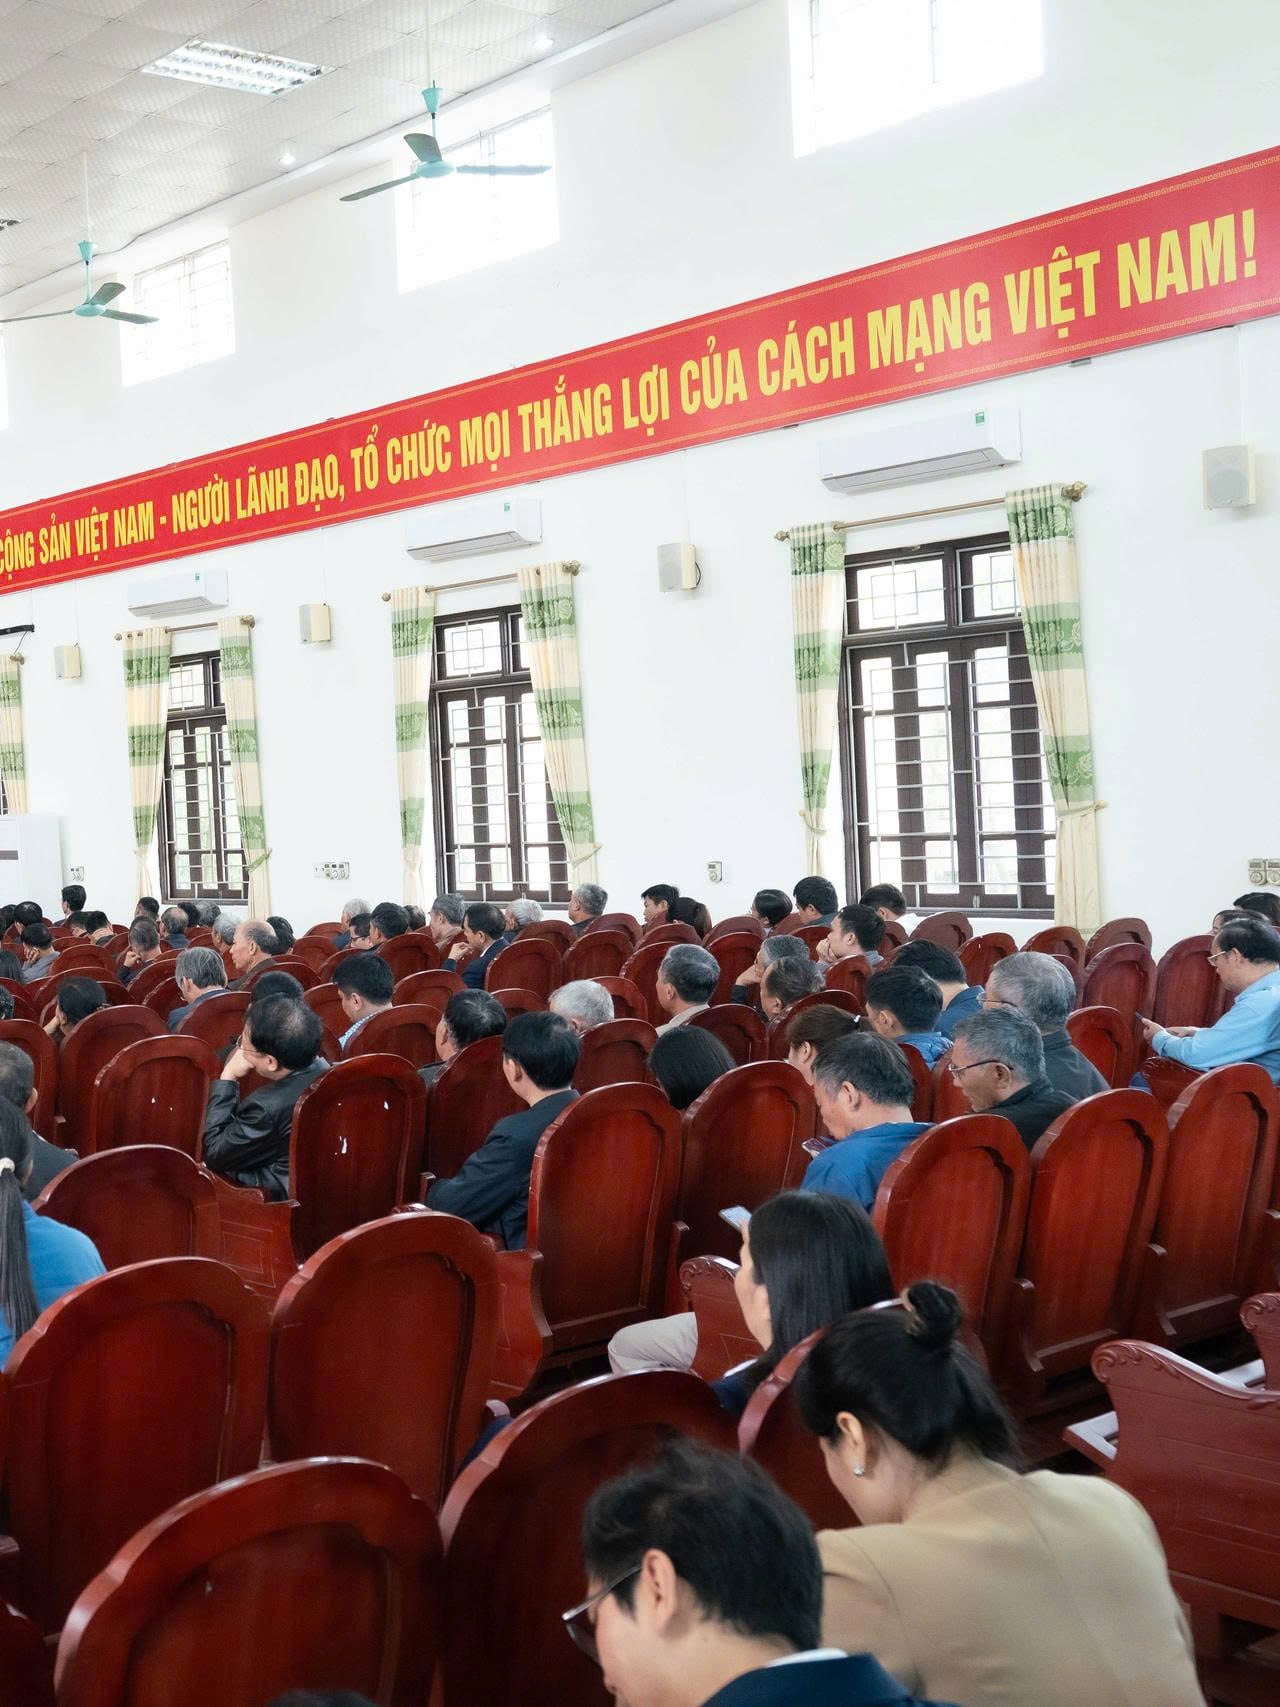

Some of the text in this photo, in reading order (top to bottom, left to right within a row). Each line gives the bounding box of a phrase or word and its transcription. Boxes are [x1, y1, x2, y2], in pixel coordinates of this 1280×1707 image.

[39, 517, 71, 564] SẢN
[75, 516, 111, 561] VIỆT
[114, 509, 155, 546] NAM
[159, 516, 167, 526] -
[172, 475, 230, 533] NGƯỜI
[234, 465, 289, 518] LÃNH
[294, 460, 345, 512] ĐẠO,
[350, 424, 380, 493] TỔ
[385, 419, 452, 485] CHỨC
[460, 411, 511, 471] MỌI
[517, 375, 613, 454] THẮNG
[622, 363, 670, 436] LỢI
[680, 335, 748, 415] CỦA
[757, 316, 855, 397] CÁCH
[866, 281, 992, 373] MẠNG
[1003, 245, 1102, 339] VIỆT
[1116, 208, 1257, 309] NAM!
